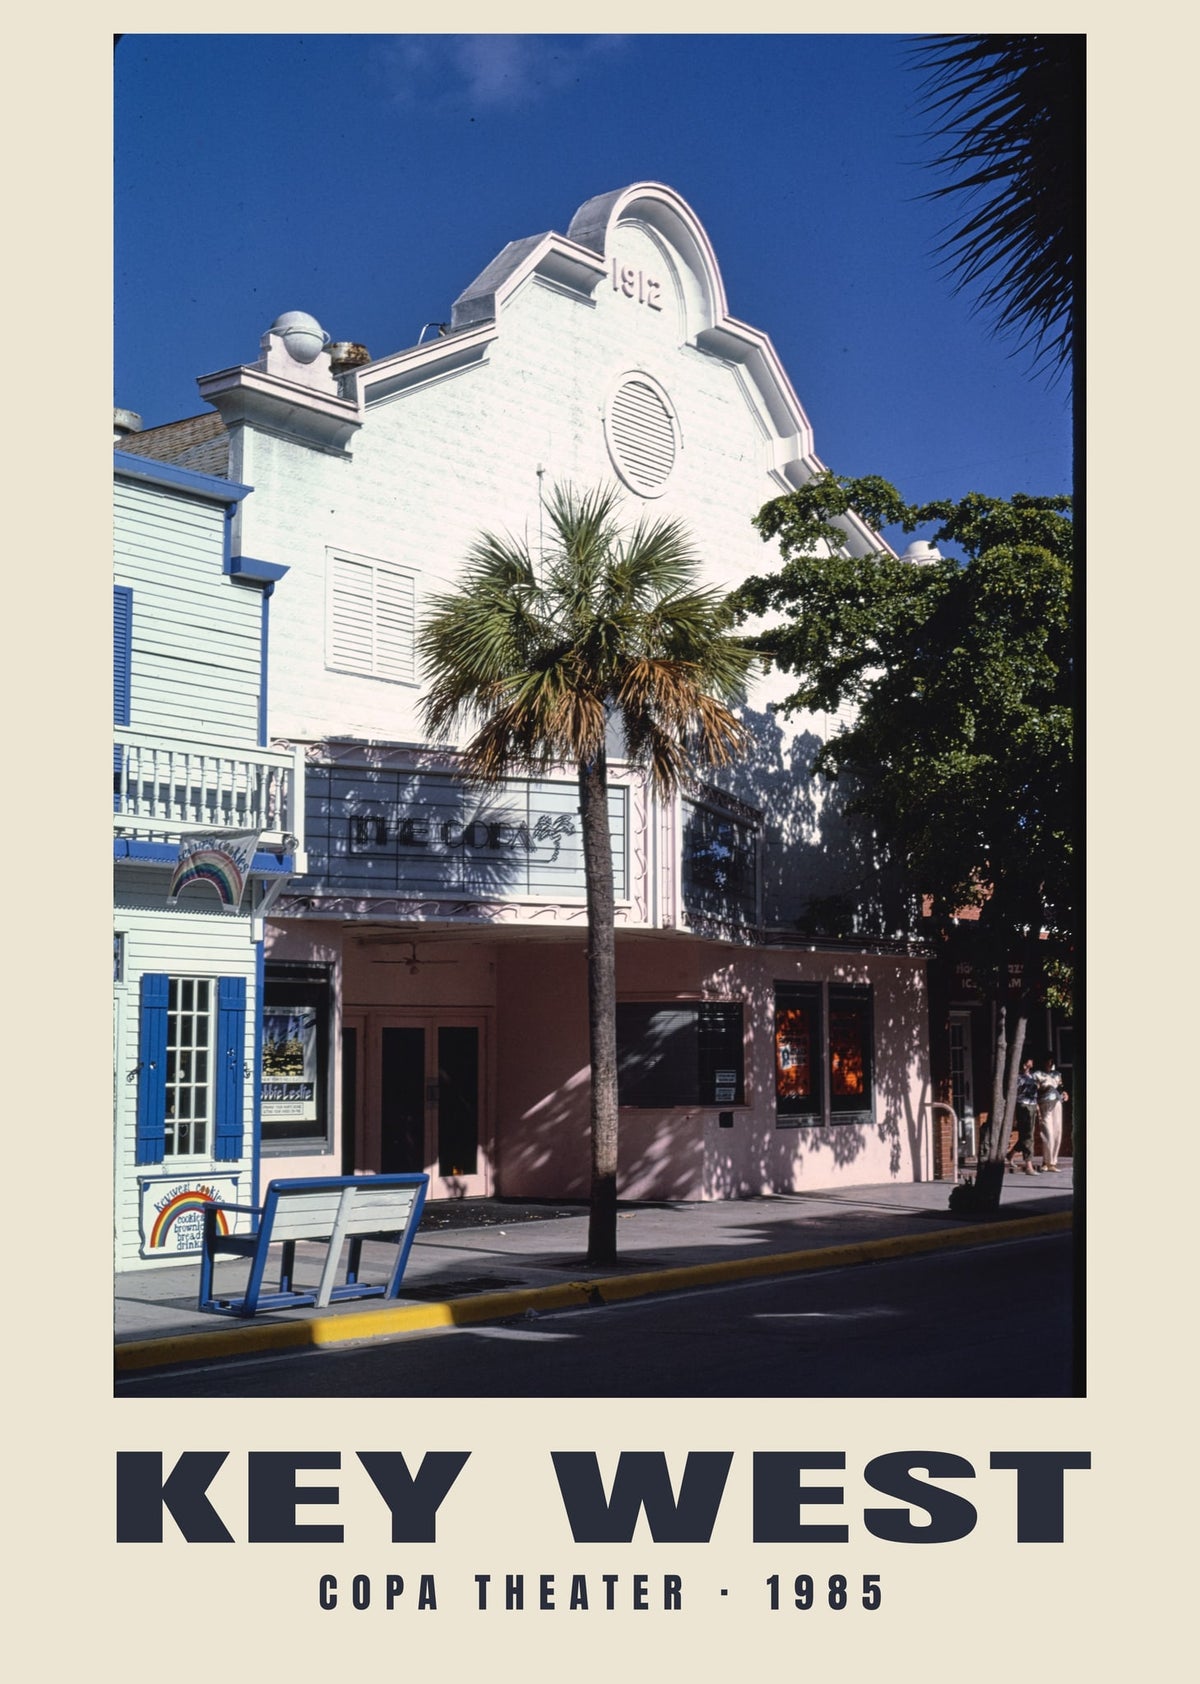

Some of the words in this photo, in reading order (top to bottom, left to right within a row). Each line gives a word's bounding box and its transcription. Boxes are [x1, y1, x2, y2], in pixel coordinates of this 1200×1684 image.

[612, 256, 663, 312] 1912
[354, 815, 429, 848] THE
[176, 1239, 203, 1250] drink
[177, 1230, 204, 1242] bread
